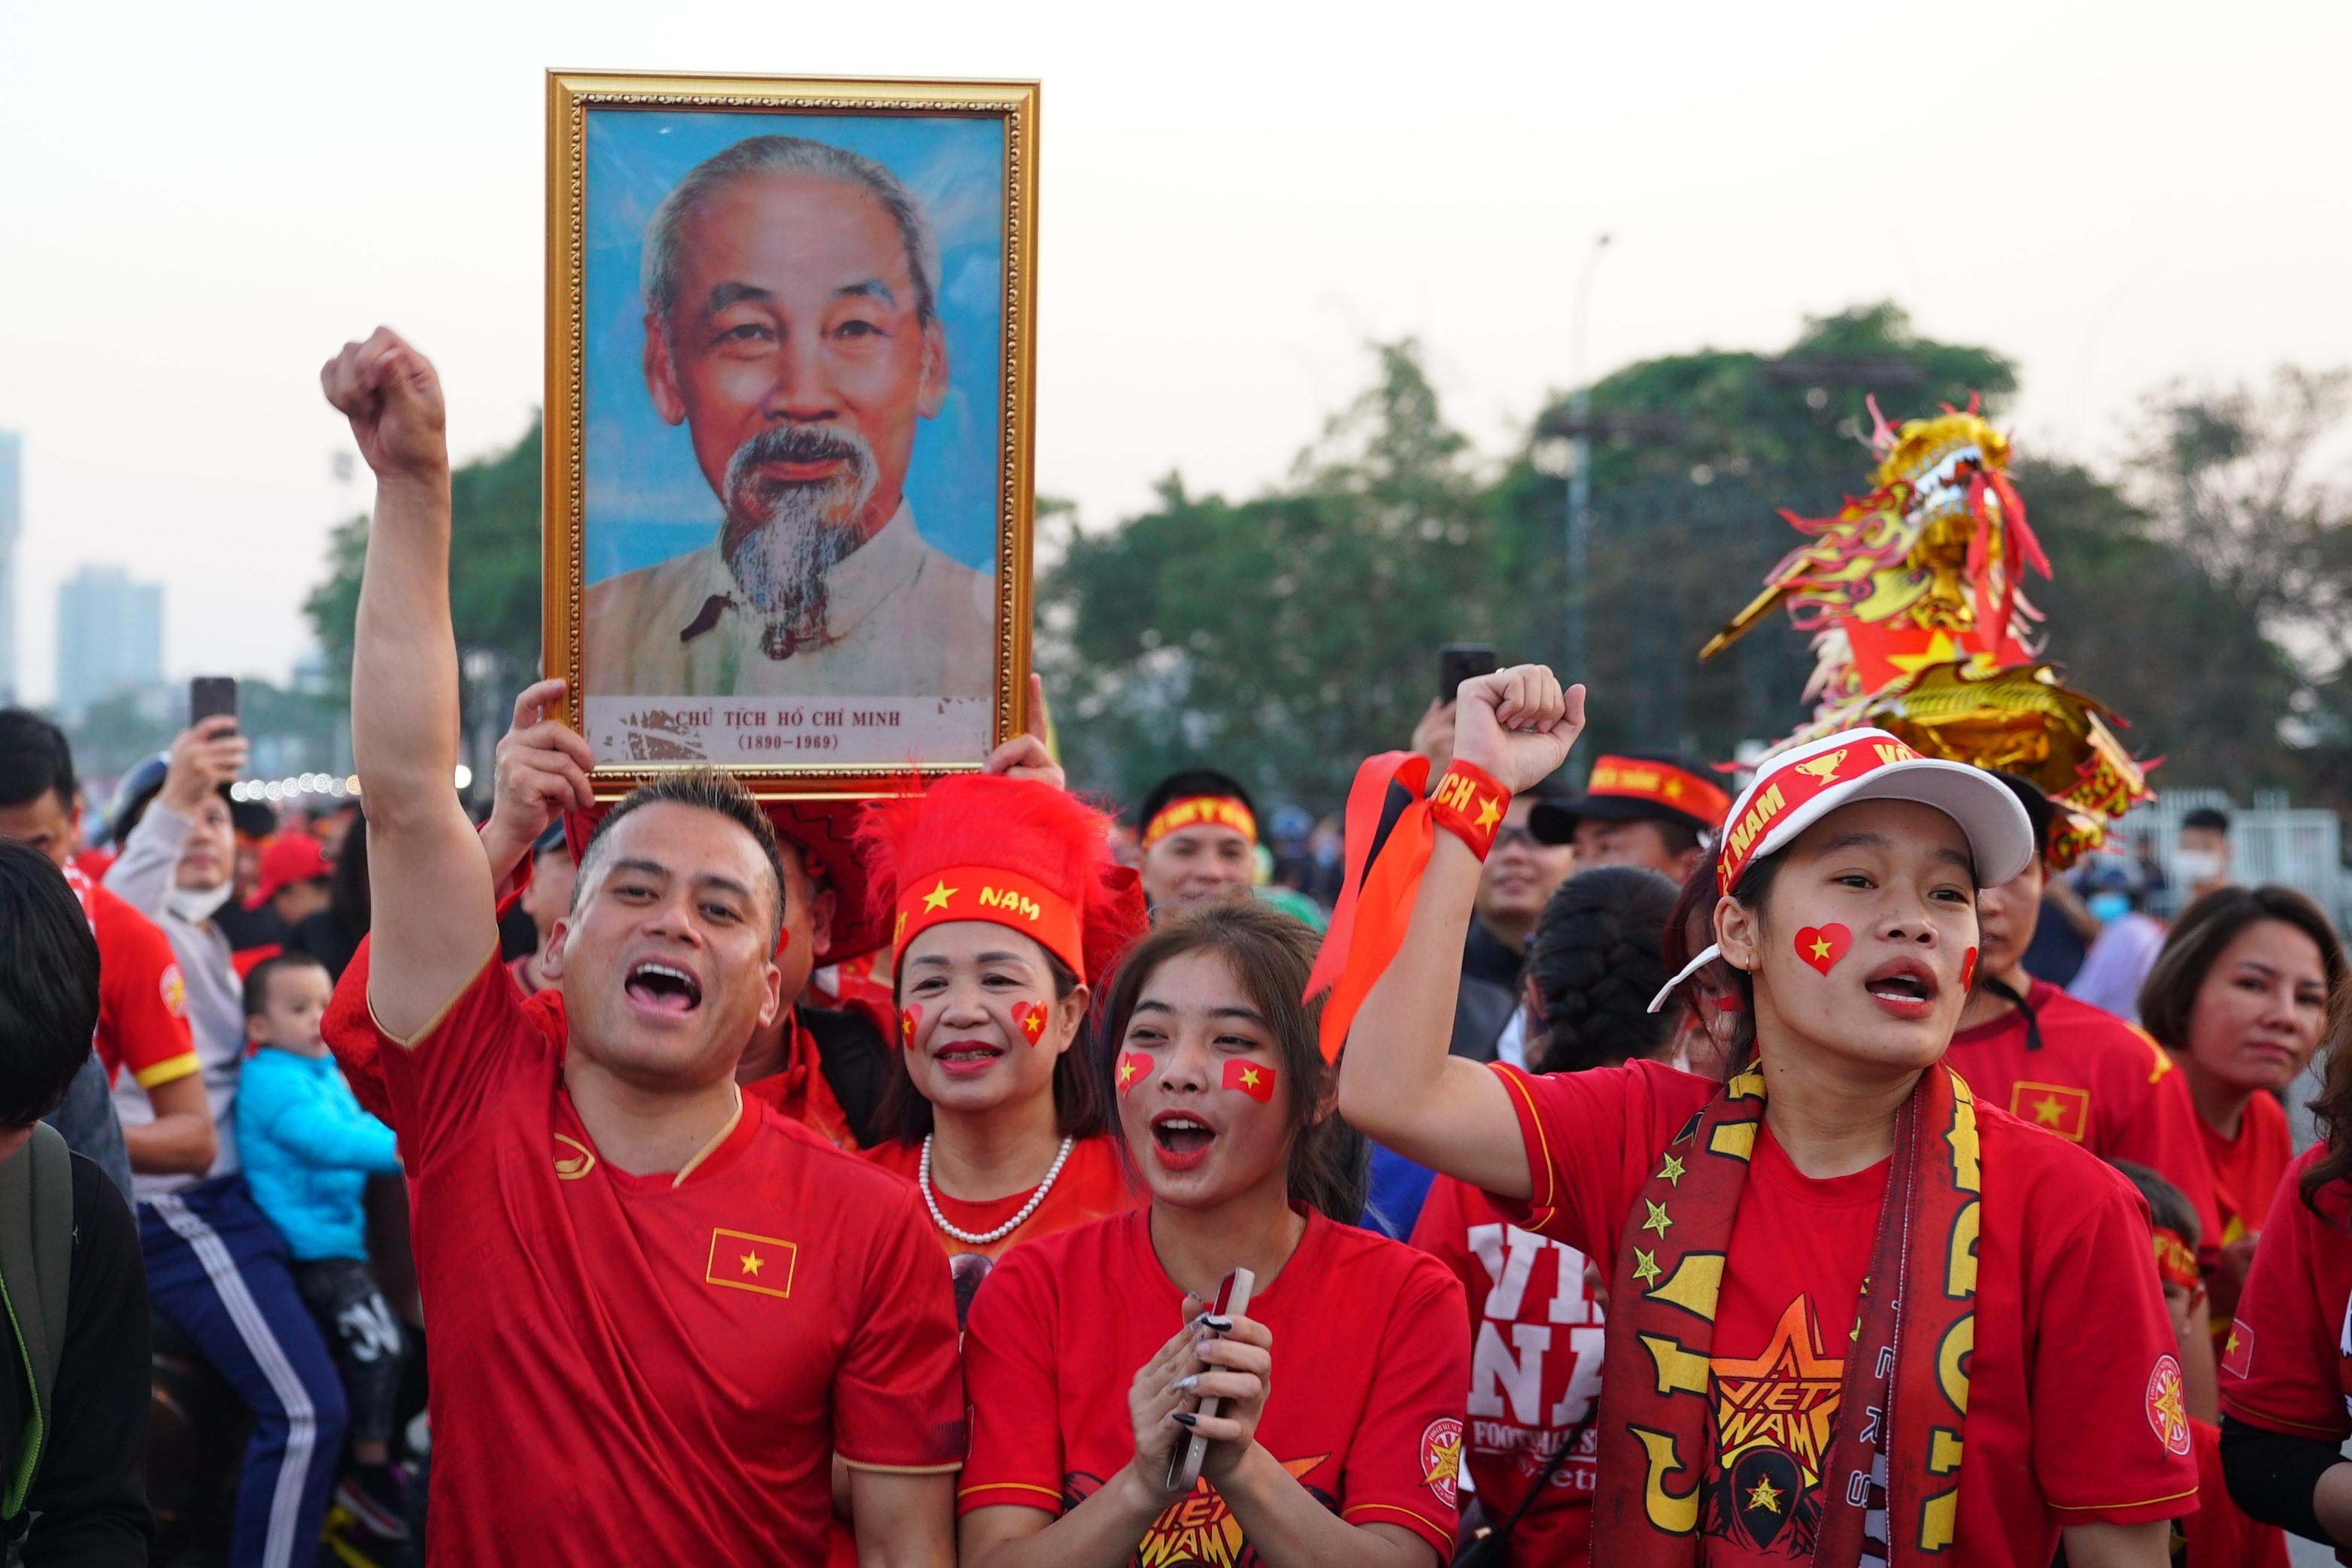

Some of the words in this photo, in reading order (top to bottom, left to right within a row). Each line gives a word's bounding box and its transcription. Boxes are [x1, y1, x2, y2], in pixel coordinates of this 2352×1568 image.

[724, 711, 766, 729] TỊCH
[812, 708, 844, 726] CHÍ
[852, 711, 900, 727] MINH
[1729, 783, 1786, 860] NAM
[979, 886, 1040, 921] NAM
[1466, 1320, 1604, 1426] NA
[1721, 1412, 1819, 1473] NAM
[1142, 1525, 1233, 1568] NAM
